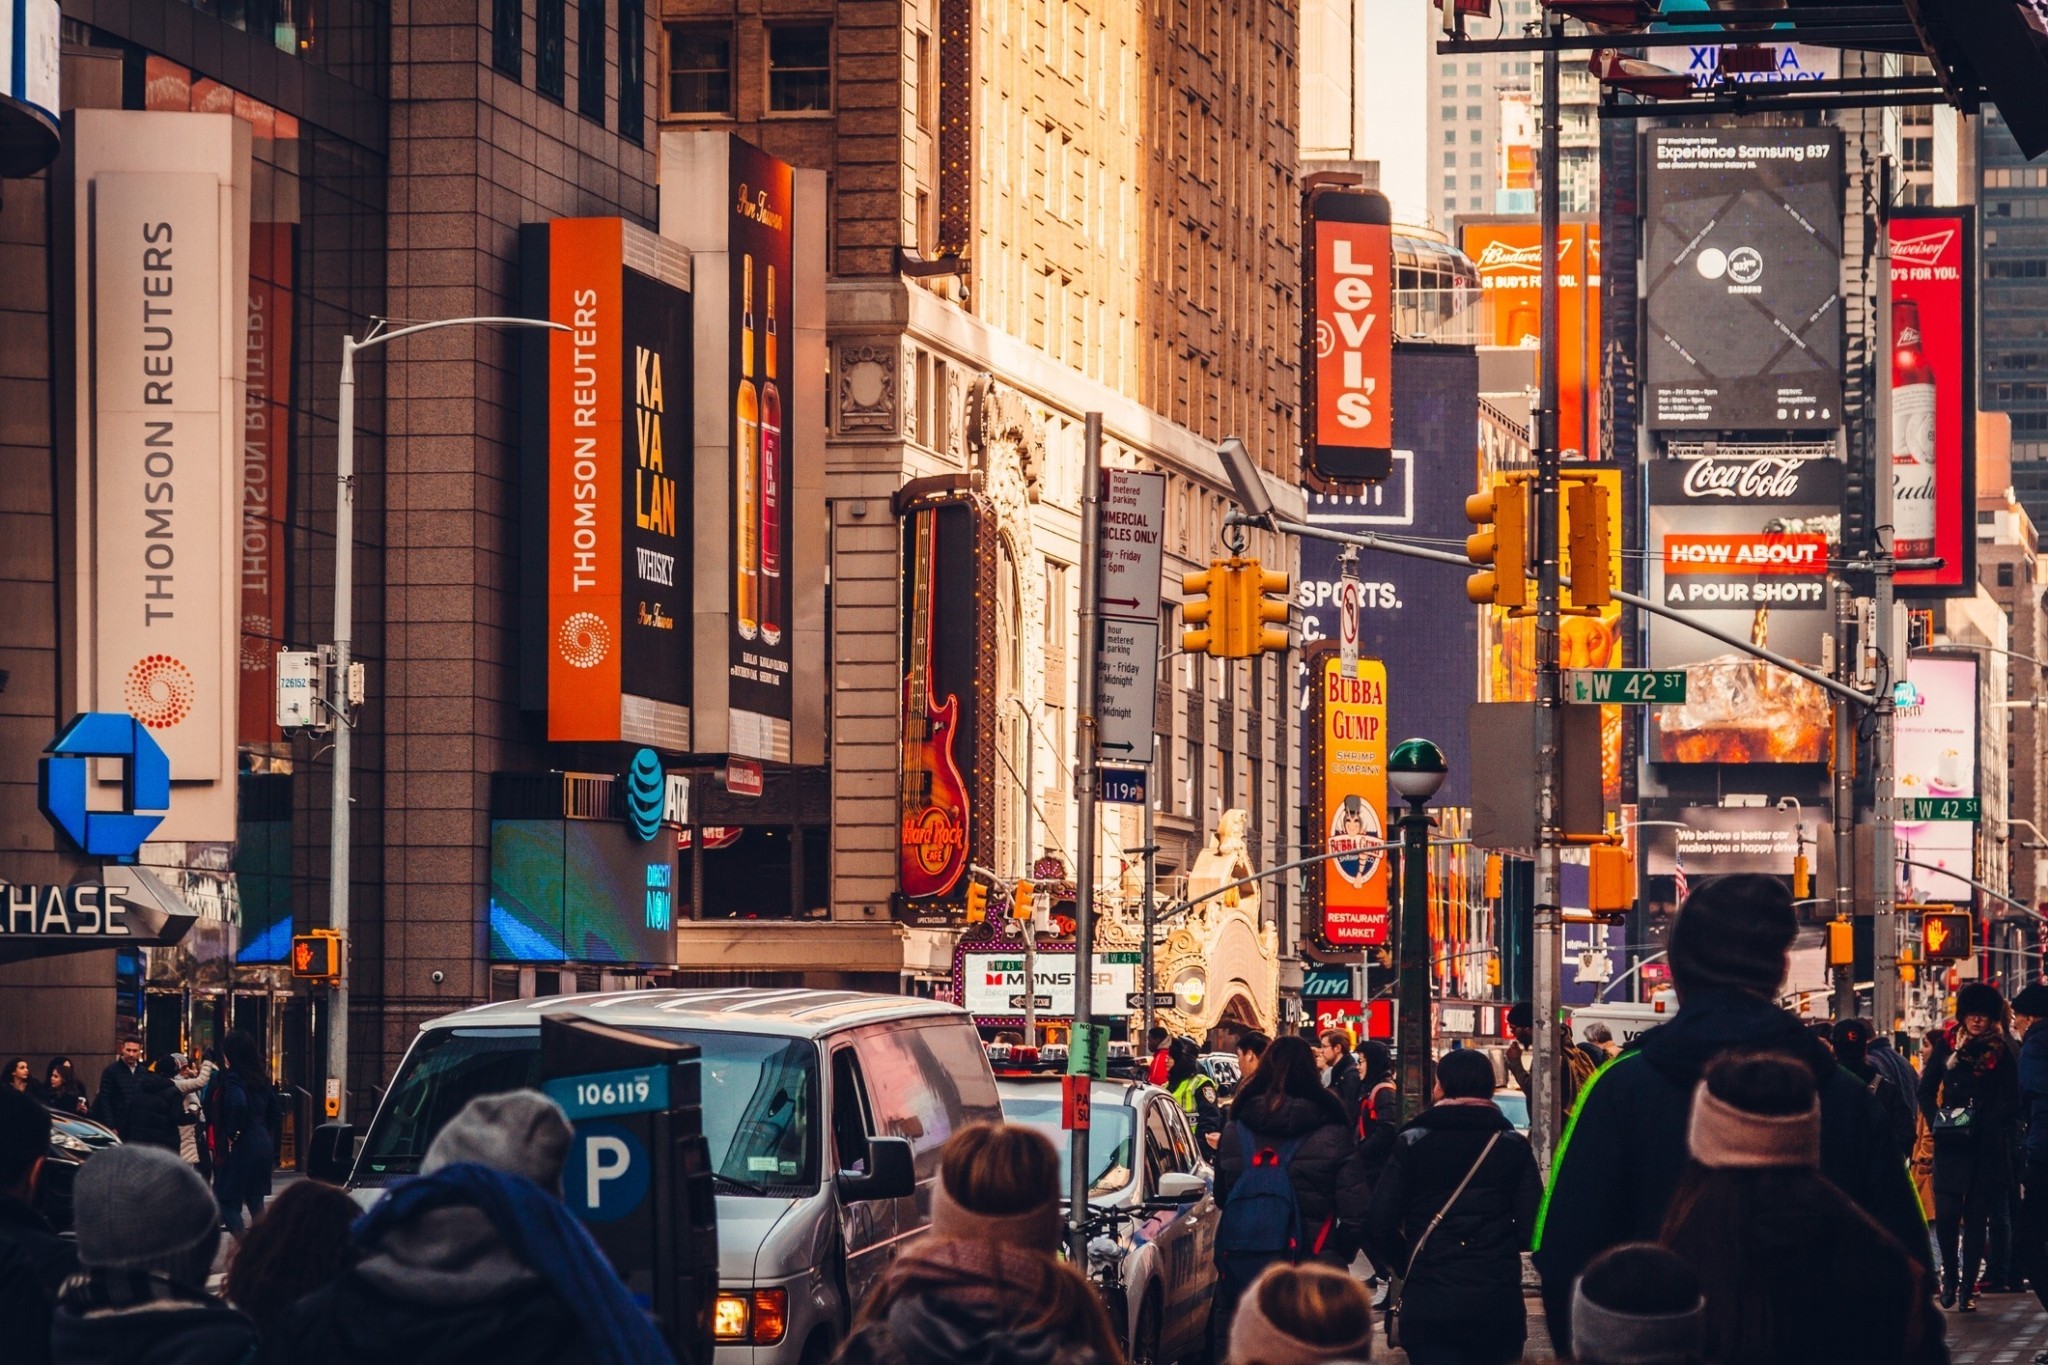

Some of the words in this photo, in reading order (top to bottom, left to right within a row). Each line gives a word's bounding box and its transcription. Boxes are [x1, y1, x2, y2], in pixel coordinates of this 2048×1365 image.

[1690, 47, 1799, 69] XIA
[1657, 145, 1736, 162] Experience
[1738, 145, 1804, 162] Samsung
[1806, 145, 1830, 159] 837
[1495, 275, 1529, 289] BUD'S
[1530, 275, 1542, 288] FO
[1559, 275, 1578, 287] OU.
[1891, 267, 1909, 282] D'S
[1910, 267, 1932, 281] FOR
[1933, 266, 1960, 280] YOU.
[143, 221, 173, 406] REUTERS
[574, 288, 597, 427] REUTERS
[1113, 475, 1129, 485] hour
[1683, 456, 1805, 498] Coca-Cola
[1113, 485, 1140, 496] metered
[1112, 495, 1137, 507] parking
[573, 437, 597, 593] THOMSON
[1101, 511, 1149, 527] MMERCIAL
[144, 421, 174, 627] THOMSON
[1101, 527, 1132, 542] HICLES
[1134, 529, 1158, 544] ONLY
[1101, 548, 1114, 561] day
[1120, 549, 1142, 563] Friday
[1671, 544, 1731, 563] HOW
[1735, 544, 1818, 563] ABOUT
[636, 547, 674, 587] WHISKY
[1108, 562, 1125, 574] 6pm
[1668, 584, 1686, 601] A
[1689, 583, 1750, 601] POUR
[1752, 583, 1823, 601] SHOT?
[1107, 625, 1122, 635] hour
[1107, 635, 1134, 646] metered
[1107, 645, 1131, 656] parking
[1099, 660, 1111, 673] day
[1117, 661, 1140, 676] Friday
[281, 678, 306, 688] 726152
[1104, 674, 1133, 688] Midnight
[1328, 672, 1383, 705] BUBBA
[1593, 674, 1613, 699] W
[1624, 673, 1657, 699] 42
[1663, 674, 1681, 688] ST
[1103, 706, 1132, 720] Midnight
[1332, 709, 1379, 741] GUMP
[1336, 751, 1376, 761] SHRIMP
[1331, 764, 1381, 775] COMPANY
[1918, 801, 1933, 819] W
[1940, 800, 1959, 819] 42
[1966, 800, 1978, 812] St
[903, 819, 935, 845] Hard
[934, 819, 964, 850] Rock
[1678, 830, 1695, 841] We
[1696, 830, 1732, 841] believe
[1732, 832, 1741, 841] a
[1741, 830, 1771, 841] better
[1772, 831, 1790, 841] car
[1330, 838, 1357, 853] BUBBA
[1678, 842, 1712, 854] makes
[1712, 844, 1732, 855] you
[1732, 844, 1740, 853] a
[1741, 843, 1773, 855] happy
[1773, 843, 1800, 853] drive
[925, 850, 943, 862] CAFE
[0, 885, 129, 935] HASE
[646, 890, 672, 931] NOW
[1327, 912, 1386, 924] RESTAURANT
[1337, 927, 1376, 938] MARKET
[1006, 961, 1015, 970] 43
[1111, 953, 1118, 963] W
[1121, 953, 1132, 962] 43
[577, 1082, 650, 1106] 106119
[586, 1135, 631, 1209] P
